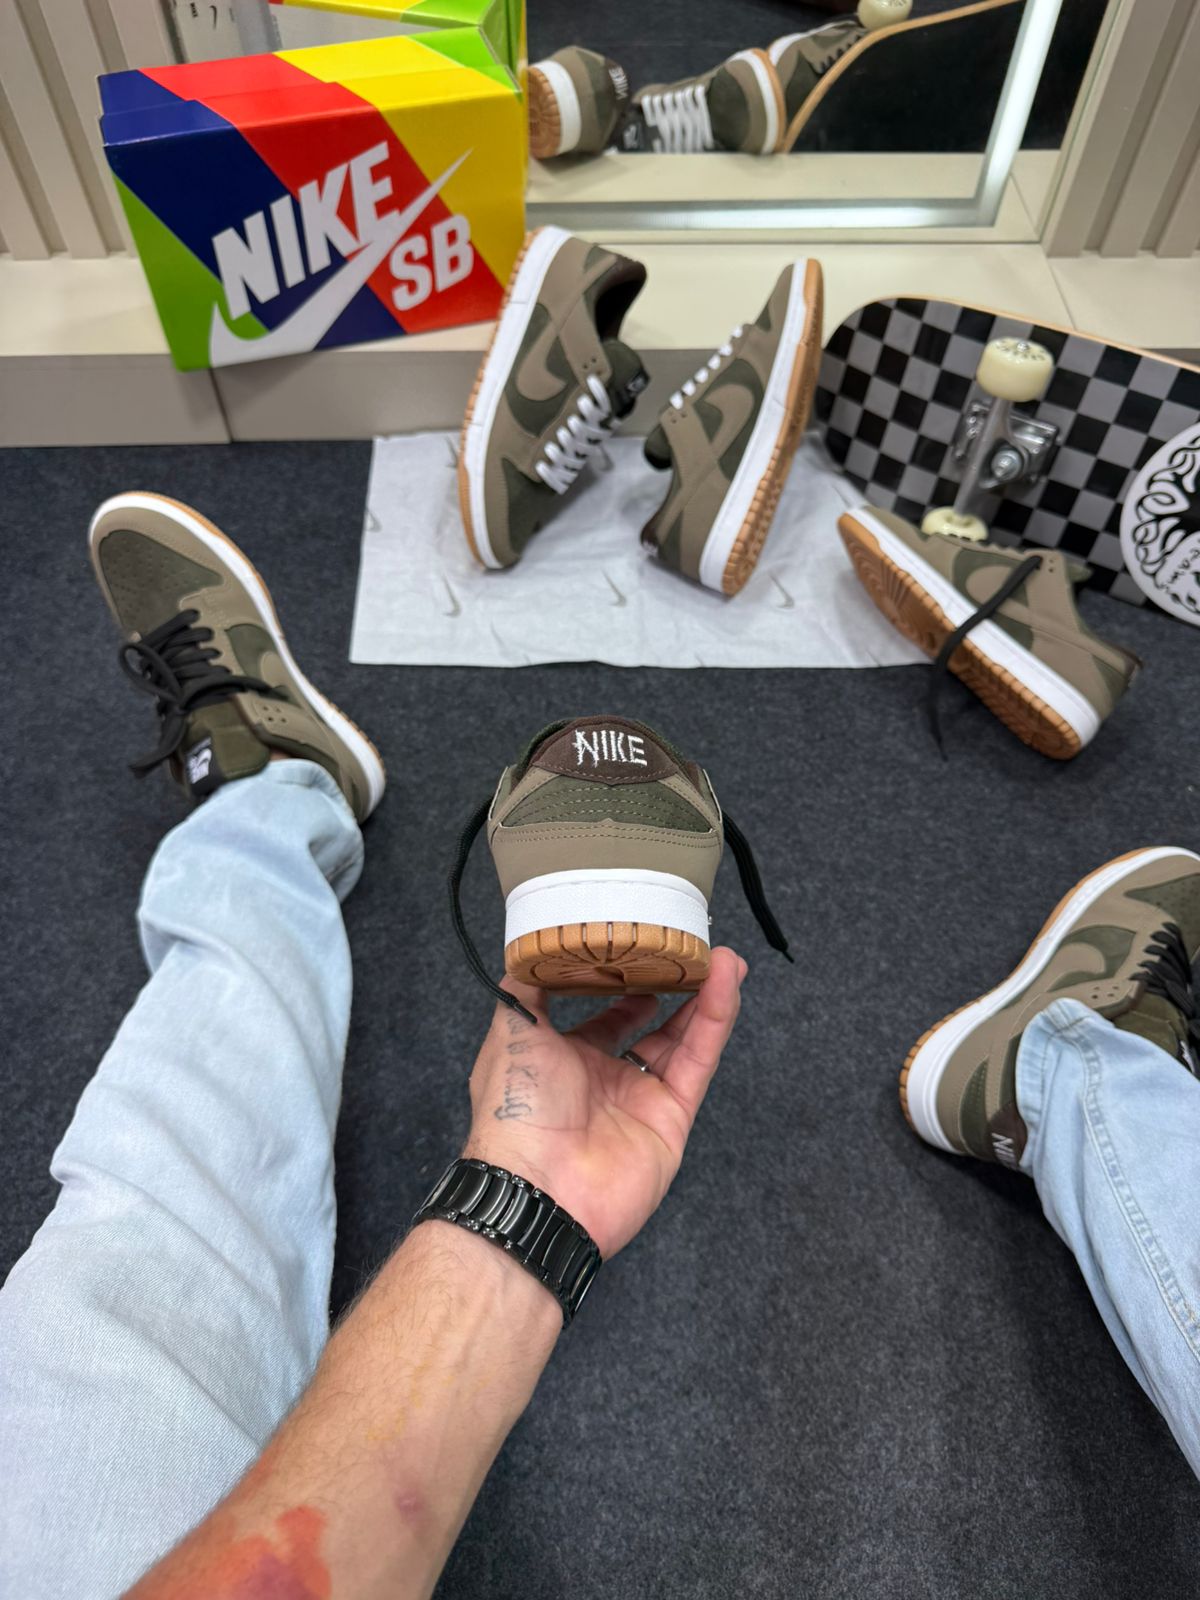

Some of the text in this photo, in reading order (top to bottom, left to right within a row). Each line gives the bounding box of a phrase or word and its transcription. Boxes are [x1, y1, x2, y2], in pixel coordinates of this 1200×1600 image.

[211, 140, 401, 321] NIKE
[389, 213, 475, 312] SB
[572, 729, 648, 769] NIKE
